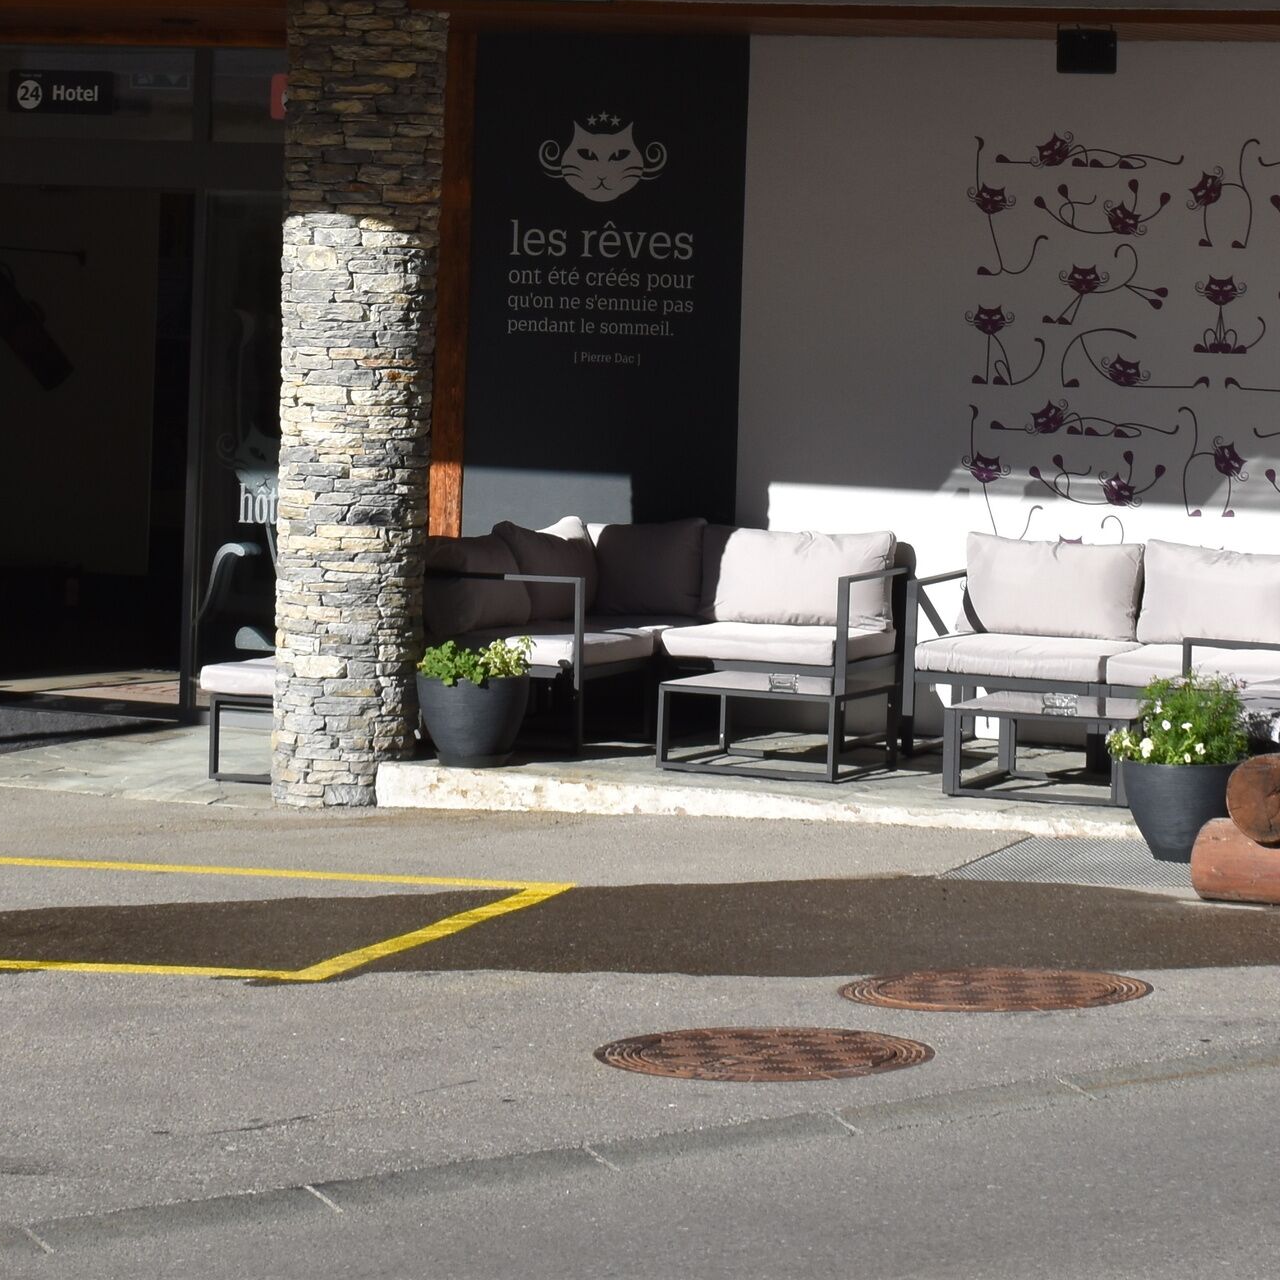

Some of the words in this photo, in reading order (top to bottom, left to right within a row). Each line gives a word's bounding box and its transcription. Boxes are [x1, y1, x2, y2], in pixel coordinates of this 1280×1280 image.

[20, 86, 40, 100] 24
[52, 85, 99, 101] Hotel
[509, 219, 567, 257] les
[580, 220, 694, 260] rêves
[508, 268, 542, 285] ont
[548, 266, 580, 286] été
[586, 268, 640, 287] créés
[647, 273, 695, 291] pour
[507, 292, 554, 310] qu'on
[559, 296, 580, 310] ne
[585, 294, 658, 312] s'ennuie
[663, 300, 694, 315] pas
[506, 317, 576, 334] pendant
[580, 318, 595, 334] le
[600, 321, 674, 336] sommeil.
[580, 352, 612, 363] Pierre
[614, 353, 634, 364] Dac
